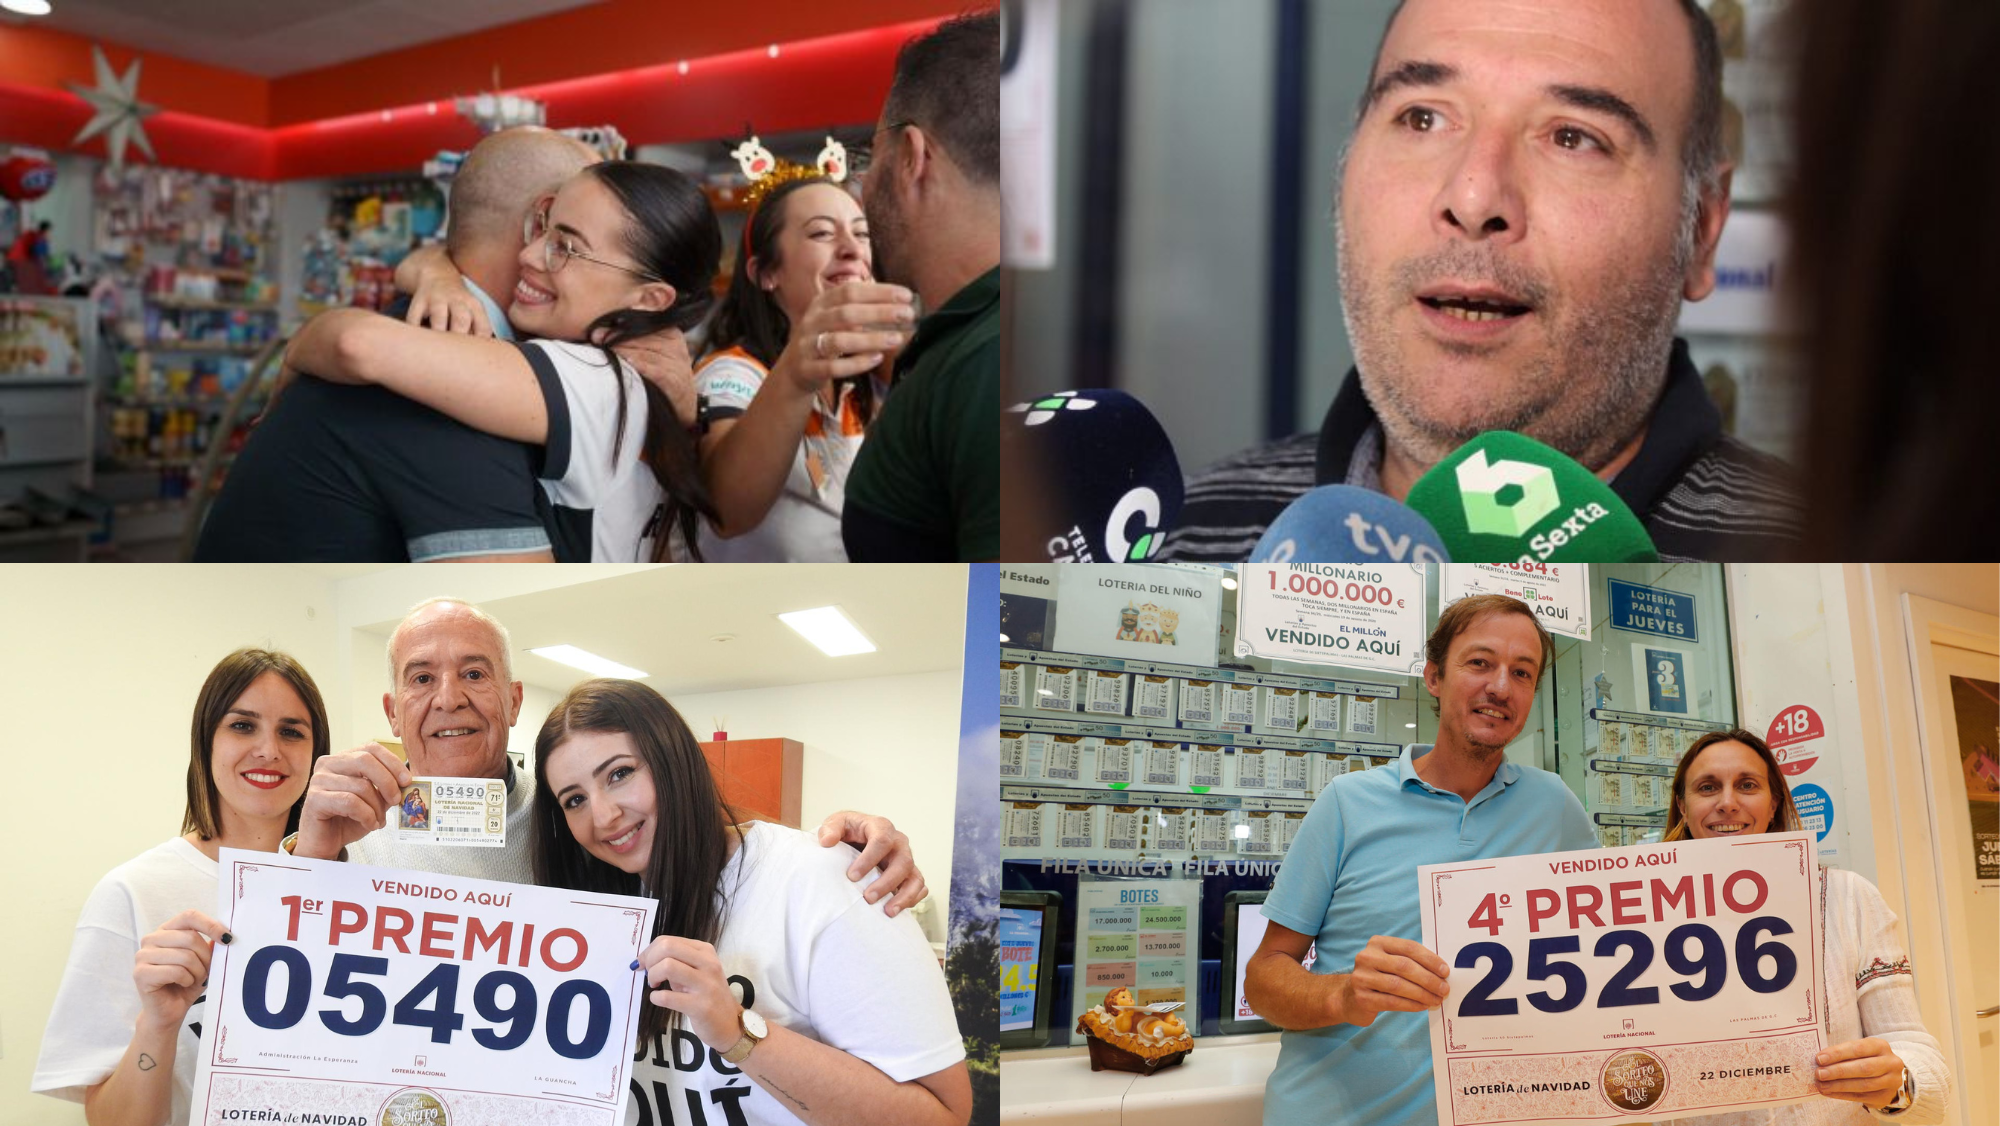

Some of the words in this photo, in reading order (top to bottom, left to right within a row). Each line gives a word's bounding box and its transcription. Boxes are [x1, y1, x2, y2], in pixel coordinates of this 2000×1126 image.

[1010, 571, 1050, 586] Estado
[1289, 563, 1383, 584] MILLONARIO
[1510, 570, 1560, 583] COMPLEMENTARIO
[1098, 577, 1146, 592] LOTERIA
[1149, 584, 1170, 595] DEL
[1172, 586, 1203, 599] NIÑO
[1267, 570, 1393, 606] 1.000.000
[1397, 599, 1405, 609] €
[1290, 595, 1300, 603] LAS
[1338, 603, 1371, 613] MILLONARIOS
[1630, 589, 1676, 606] LOTERÍA
[1302, 603, 1316, 611] TOCA
[1351, 609, 1371, 617] ESPAÑA
[1535, 604, 1569, 621] AQUÍ
[1631, 602, 1662, 616] PARA
[1665, 608, 1677, 618] EL
[1340, 625, 1351, 633] EL
[1352, 627, 1387, 637] MILLÓN
[1626, 614, 1685, 635] JUEVES
[1265, 627, 1350, 650] VENDIDO
[1356, 639, 1401, 656] AQUÍ
[1657, 660, 1676, 685] 3
[1775, 709, 1809, 736] +18
[435, 786, 485, 798] 05490
[1792, 792, 1817, 802] CENTRO
[1796, 797, 1826, 808] ATENCIÓN
[1040, 856, 1091, 874] FILA
[1184, 859, 1229, 876] FILA
[1548, 856, 1629, 876] VENDIDO
[1634, 848, 1678, 869] AQUÍ
[371, 878, 458, 902] VENDIDO
[463, 889, 512, 909] AQUÍ
[1120, 889, 1159, 903] BOTES
[1467, 892, 1513, 937] 4º
[1526, 869, 1769, 933] PREMIO
[1095, 917, 1132, 925] 17.000.000
[280, 894, 324, 942] 1er
[328, 899, 589, 973] PREMIO
[1001, 946, 1033, 962] BOTE
[1095, 945, 1129, 953] 2.700.000
[1151, 970, 1173, 978] 10.000
[1454, 915, 1797, 1018] 25296
[1000, 963, 1038, 992] 4.5
[1097, 973, 1125, 981] 850.000
[242, 944, 612, 1060] 05490
[1603, 1032, 1626, 1040] LOTERÍA
[1627, 1030, 1656, 1038] NACIONAL
[258, 1051, 311, 1060] Administración
[1613, 1065, 1655, 1086] SORTEO
[1700, 1071, 1715, 1080] 22
[1719, 1065, 1791, 1079] DICIEMBRE
[545, 1077, 577, 1086] GUANCHA
[1463, 1080, 1514, 1095] LOTERÍA
[1516, 1082, 1530, 1094] de
[1531, 1080, 1591, 1093] NAVIDAD
[221, 1108, 282, 1122] LOTERÍA
[283, 1112, 299, 1123] de
[301, 1113, 368, 1126] NAVIDAD
